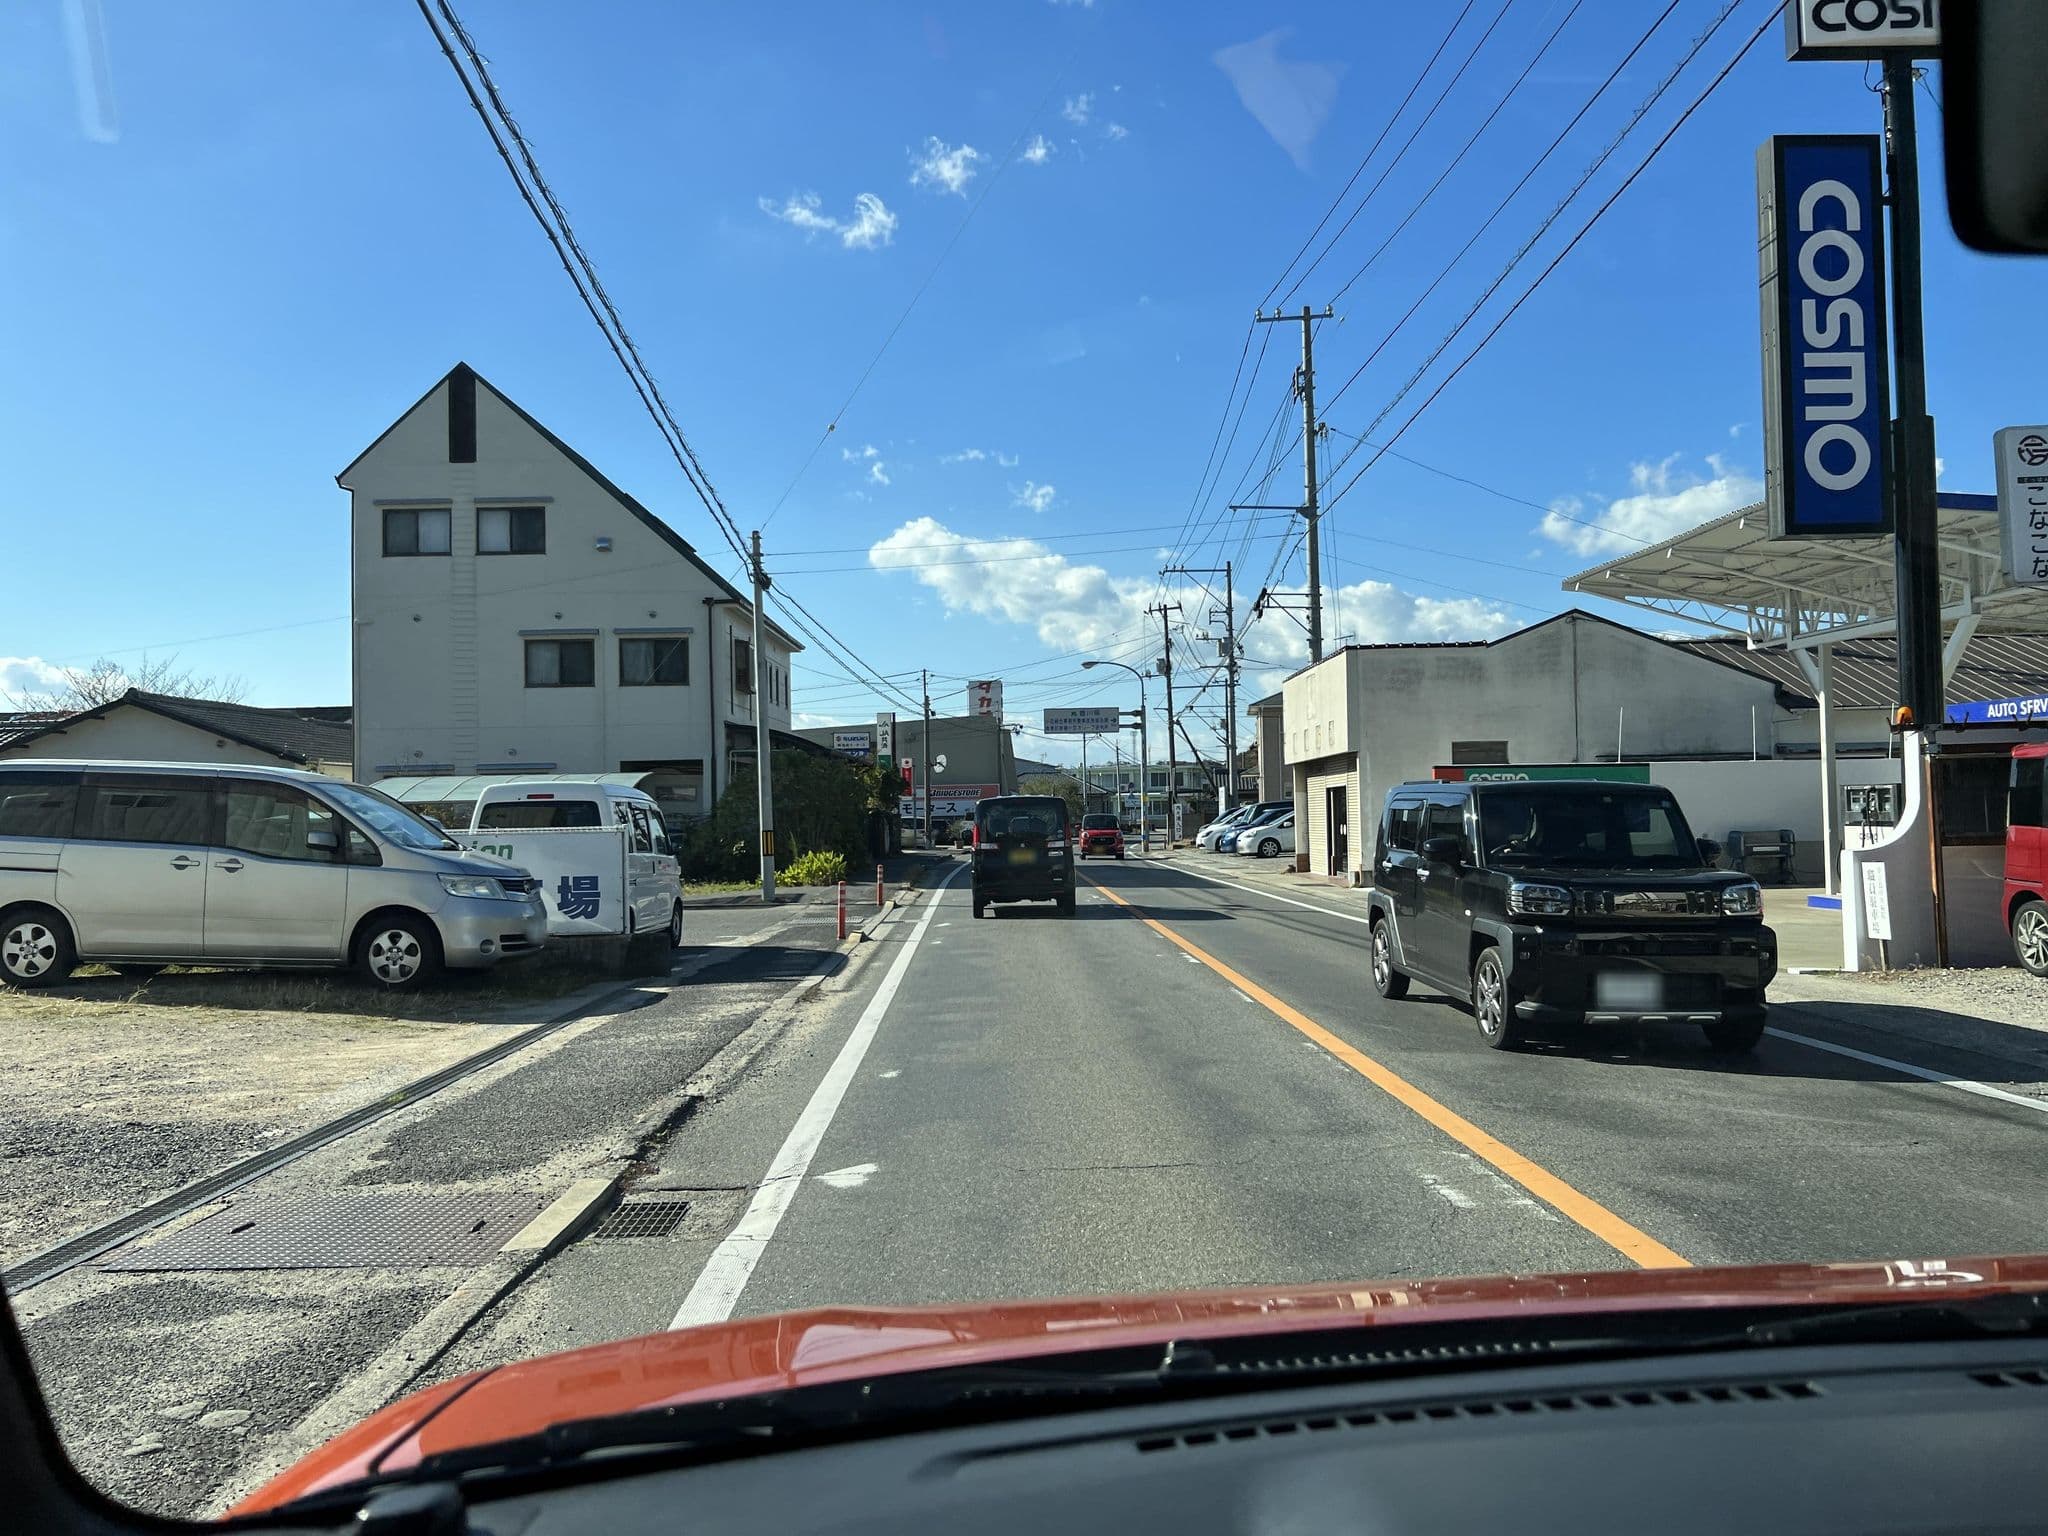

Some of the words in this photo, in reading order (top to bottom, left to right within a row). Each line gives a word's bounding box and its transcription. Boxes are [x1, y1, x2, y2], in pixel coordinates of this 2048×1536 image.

[1798, 179, 1872, 491] COSMO
[1987, 702, 2018, 718] AUTO
[537, 875, 601, 920] 場
